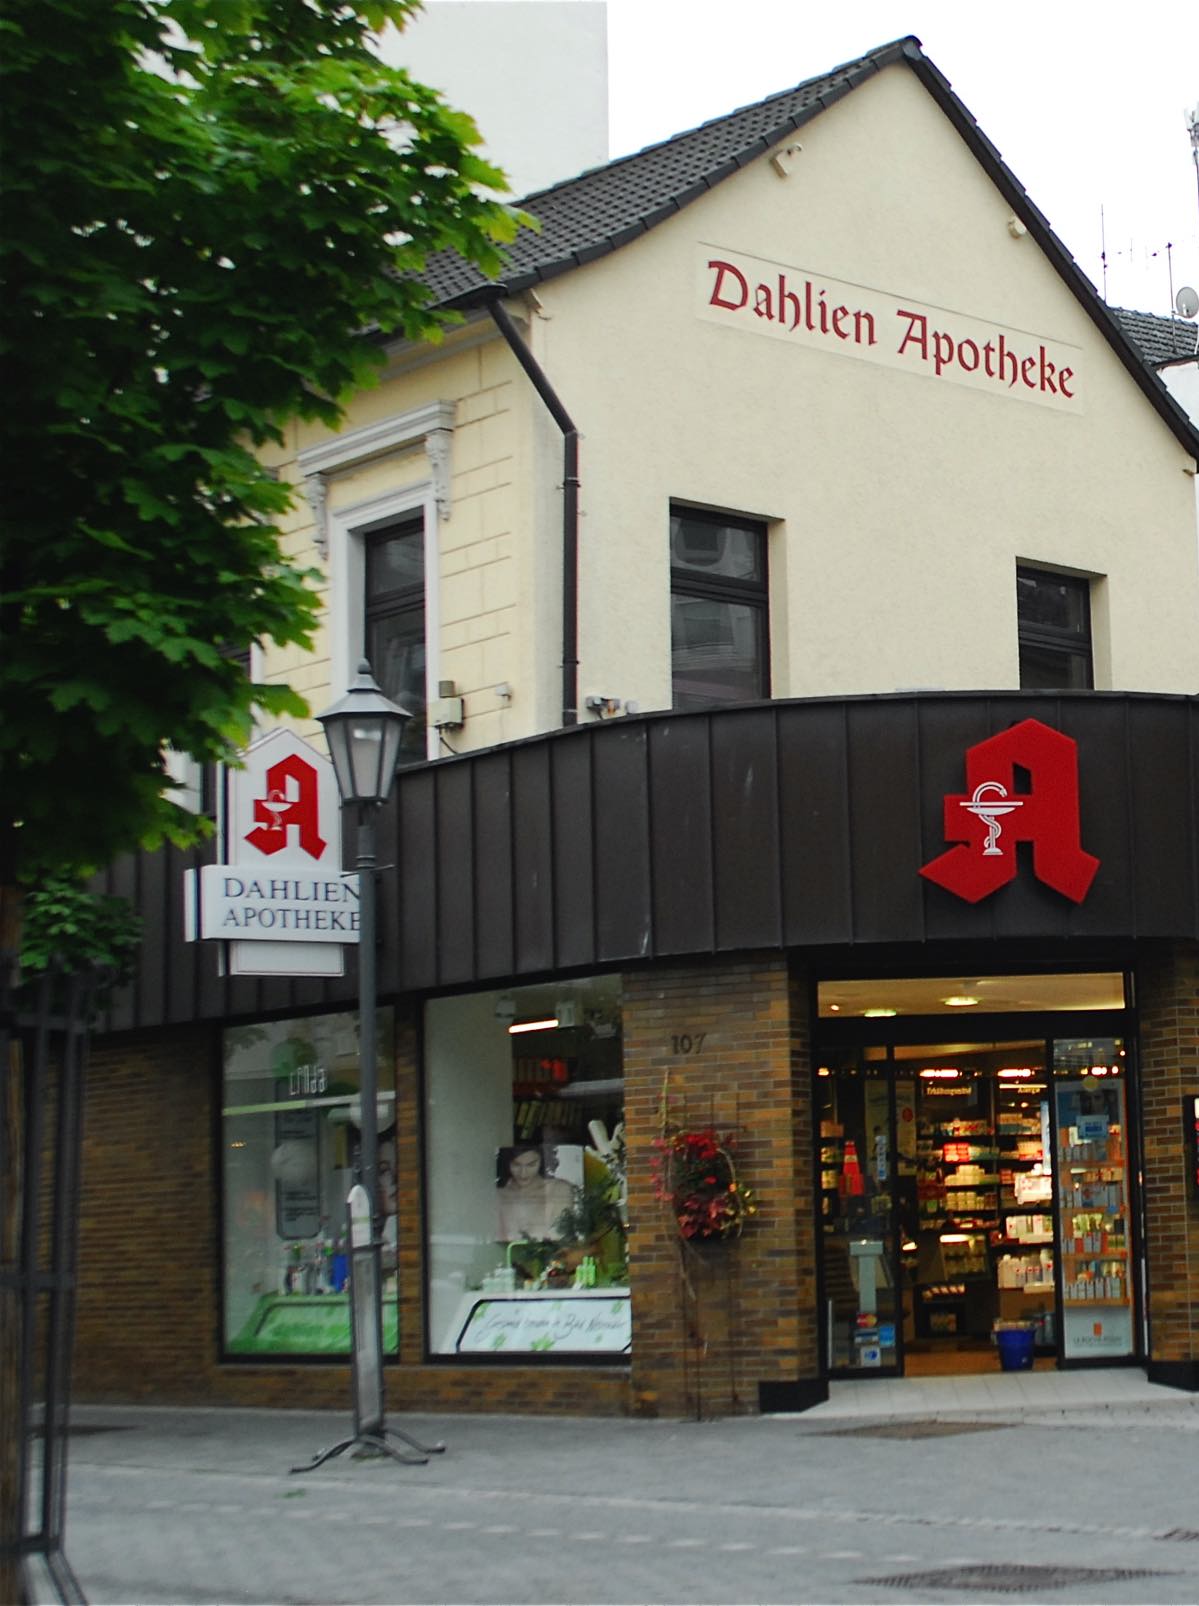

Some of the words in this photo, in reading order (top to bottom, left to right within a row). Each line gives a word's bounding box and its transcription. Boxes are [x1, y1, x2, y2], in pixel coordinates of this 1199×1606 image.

[707, 260, 878, 346] Dahlien
[896, 308, 1075, 399] Apotheke
[224, 877, 360, 903] DAHLIEN
[223, 907, 360, 931] APOTHEKE
[670, 1032, 707, 1055] 107
